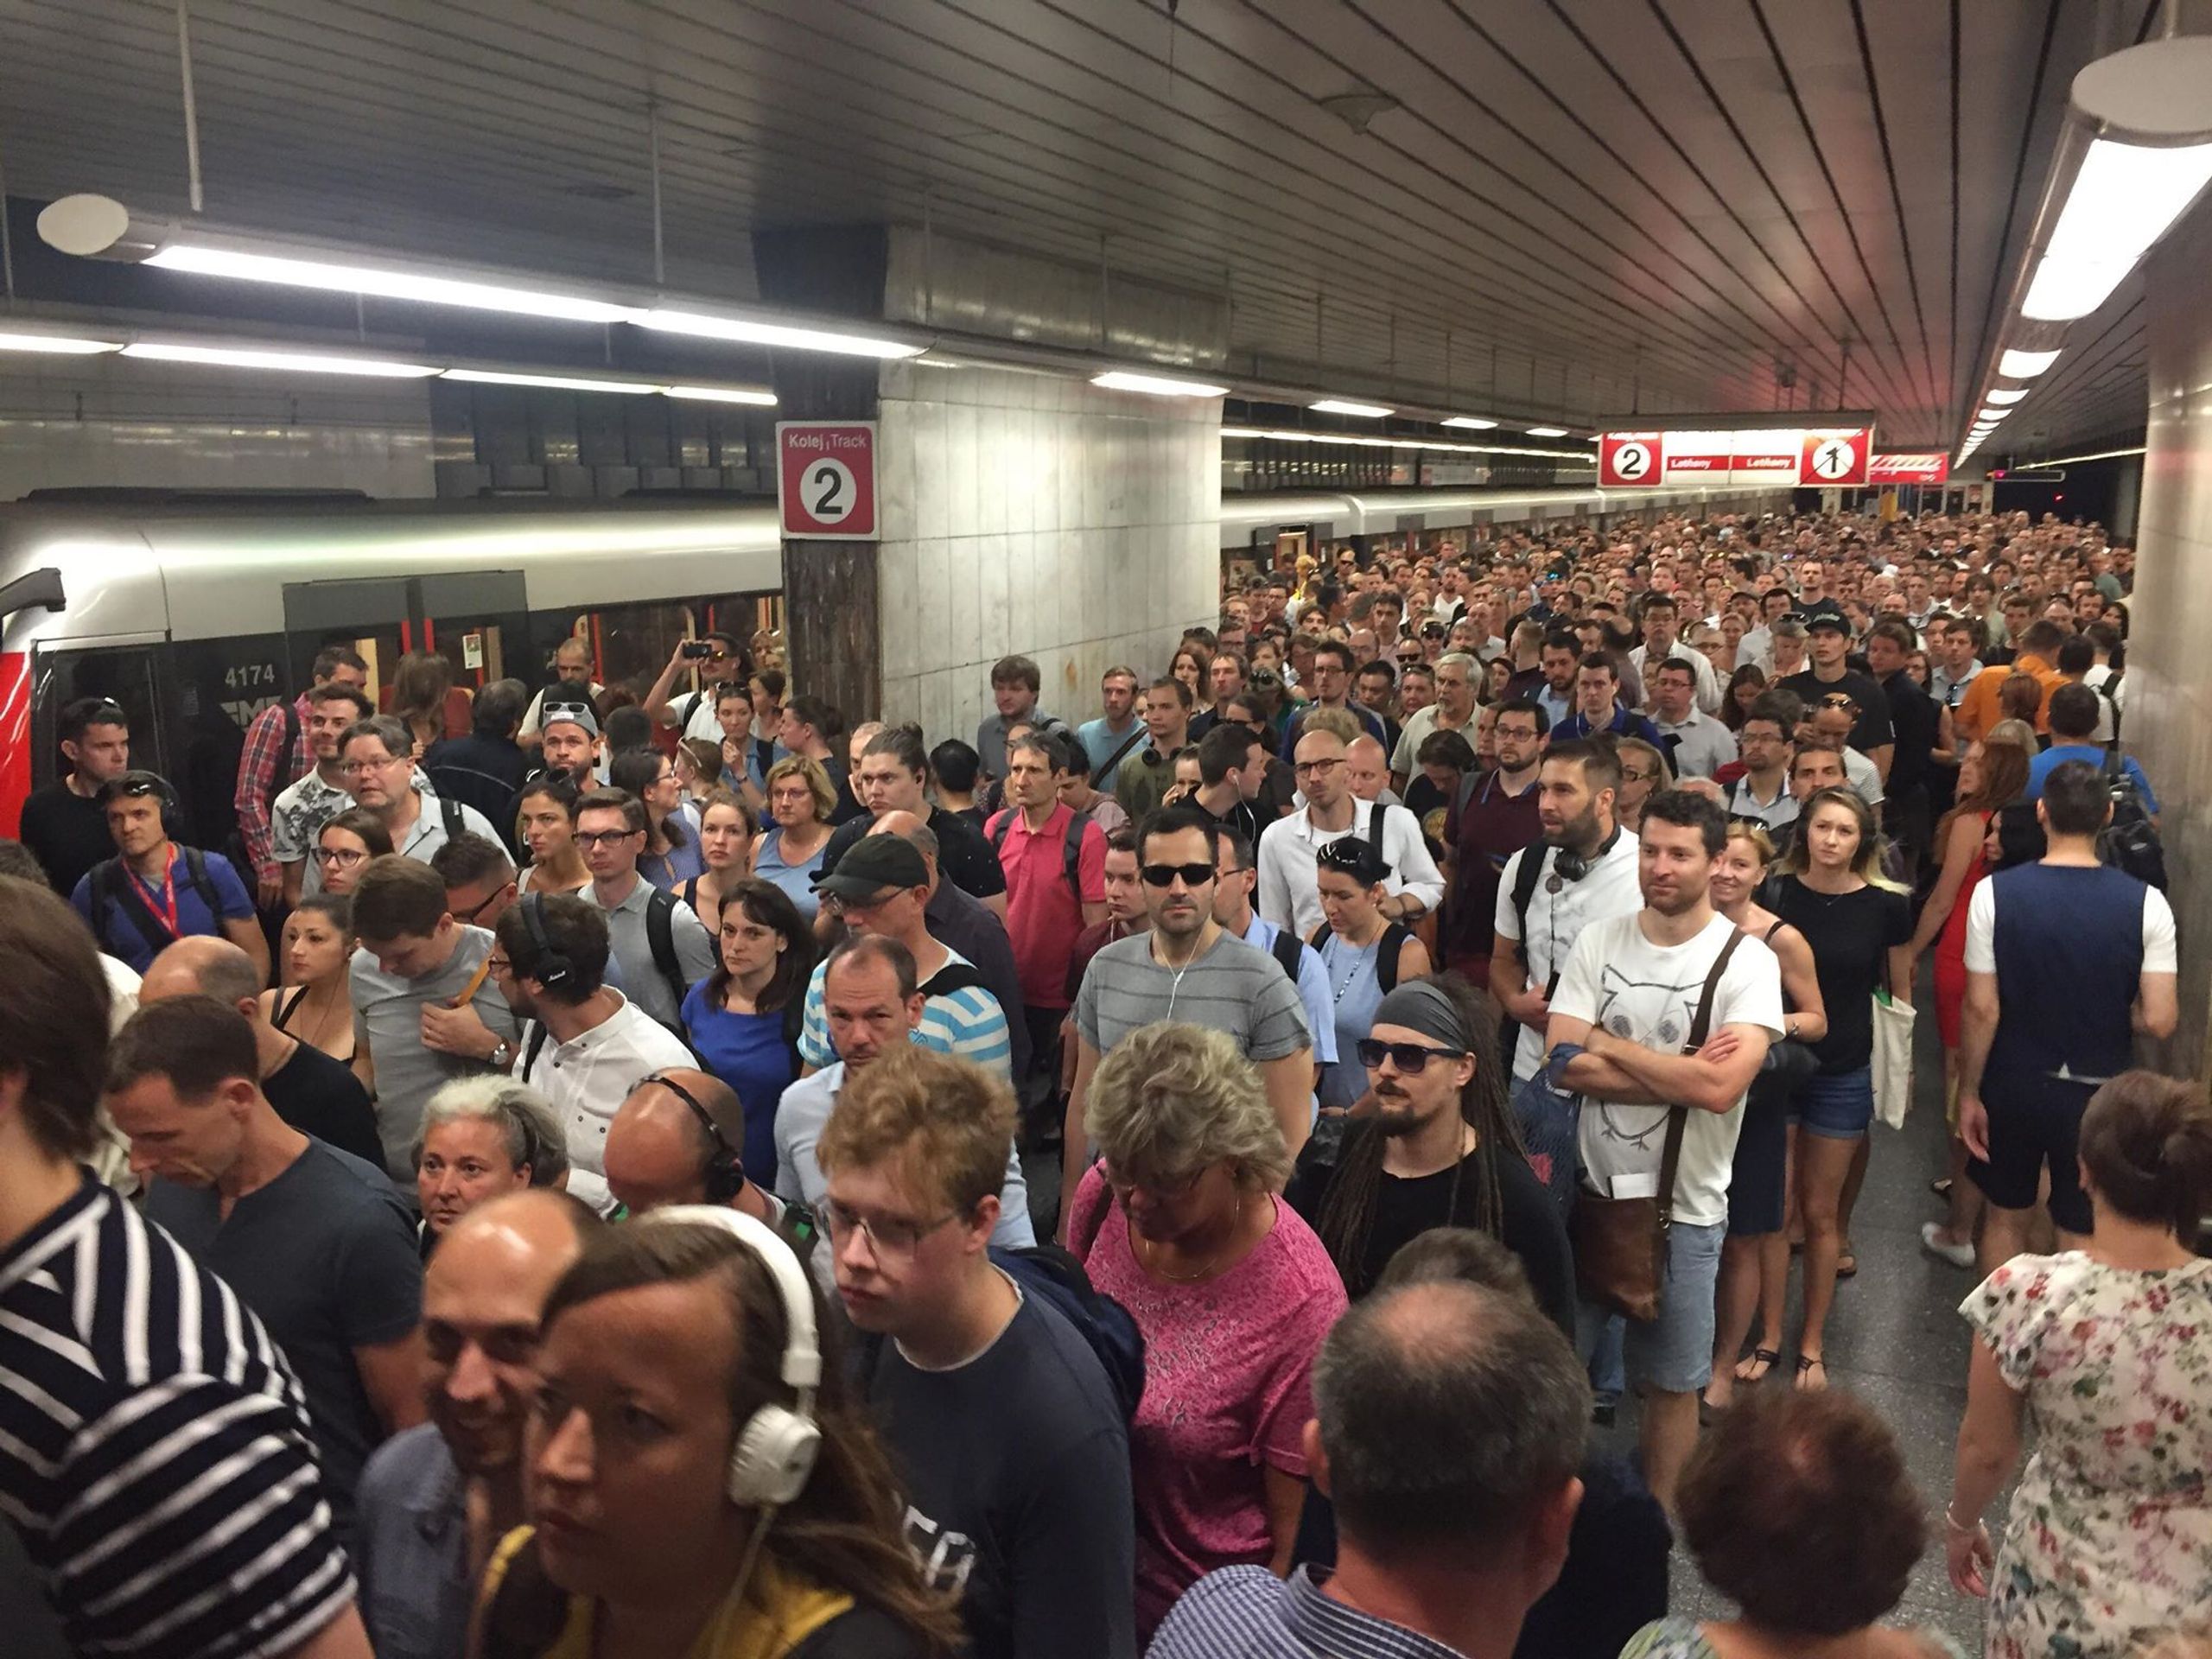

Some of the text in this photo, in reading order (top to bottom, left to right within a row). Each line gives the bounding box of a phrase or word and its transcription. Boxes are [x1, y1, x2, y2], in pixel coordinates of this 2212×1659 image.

[788, 434, 867, 451] Kolej Track
[1622, 448, 1641, 474] 2
[1826, 447, 1839, 473] 1
[814, 467, 843, 514] 2
[225, 663, 276, 689] 4174
